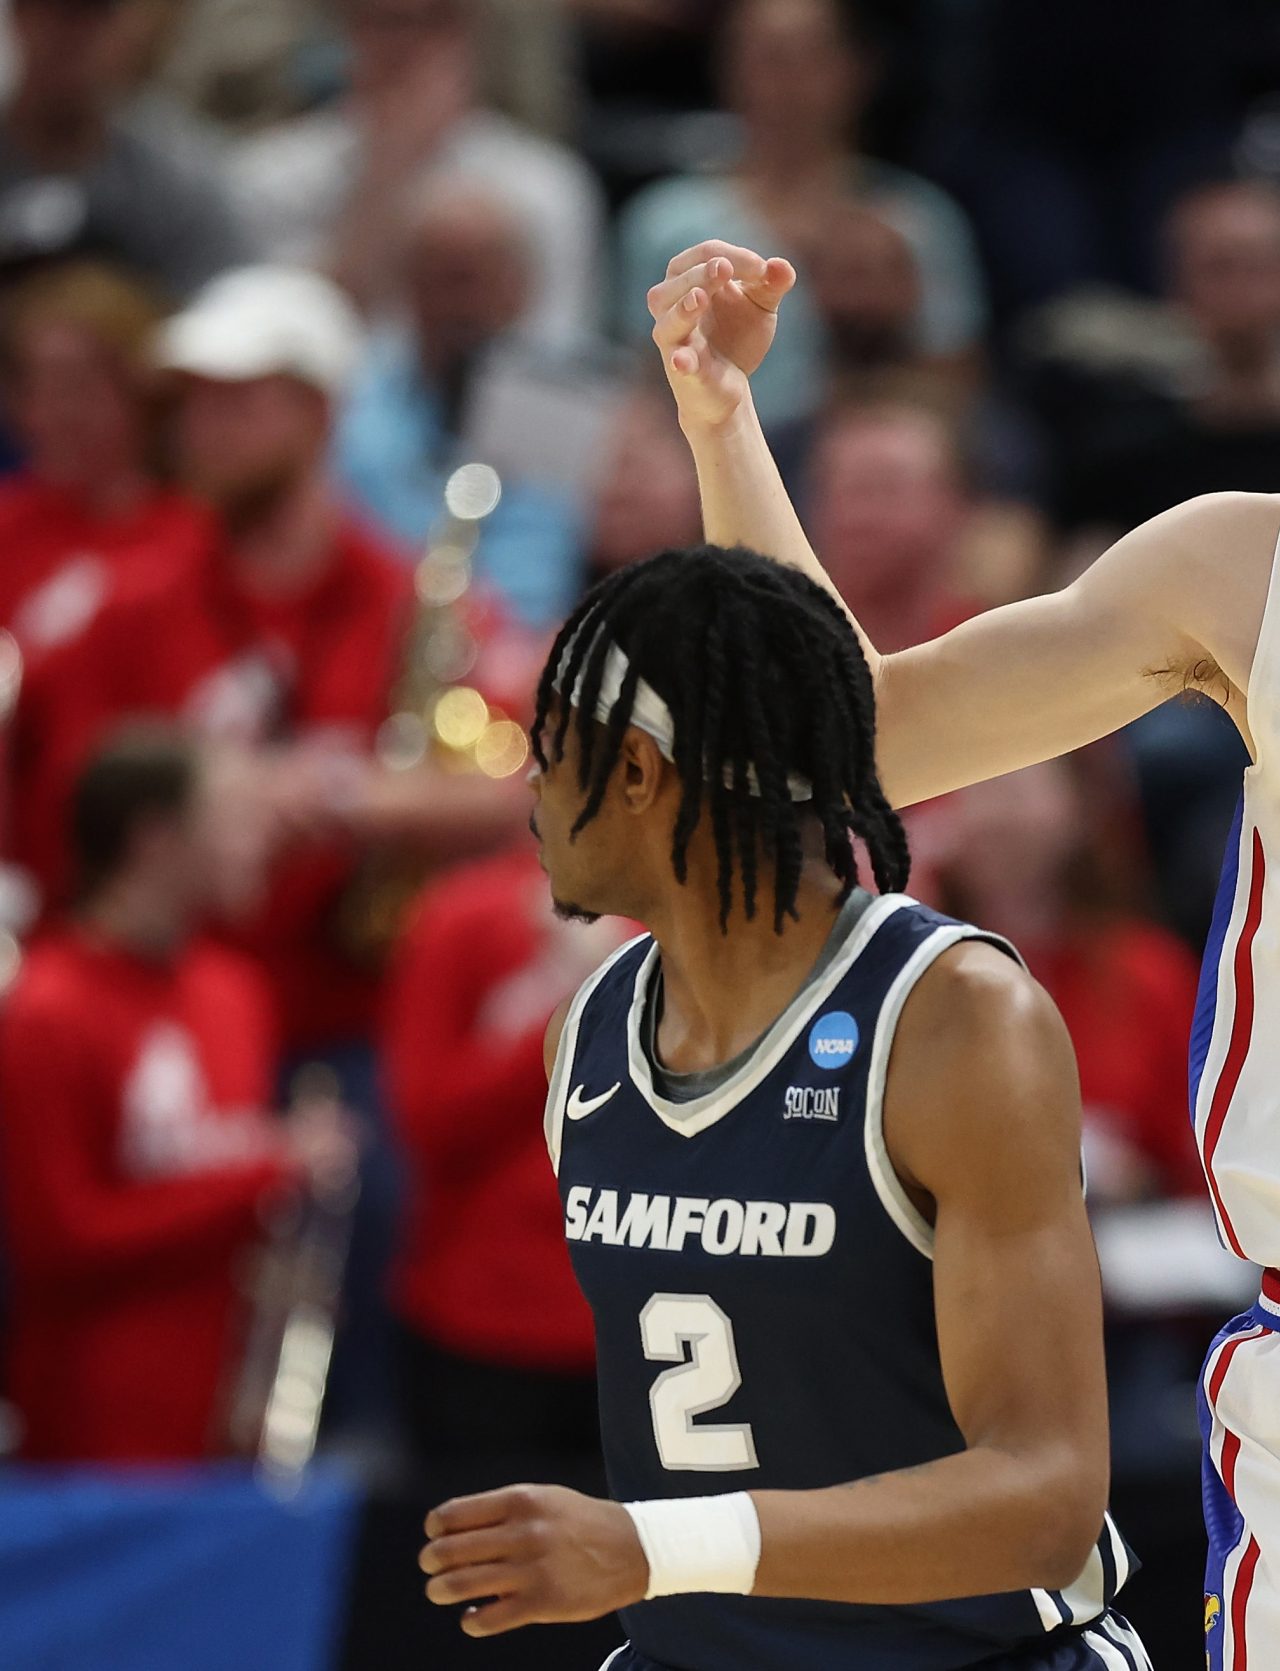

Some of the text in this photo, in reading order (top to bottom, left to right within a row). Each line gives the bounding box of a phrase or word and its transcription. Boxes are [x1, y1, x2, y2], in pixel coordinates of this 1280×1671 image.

[814, 1038, 854, 1055] NCAA
[565, 1186, 837, 1258] SAMFORD
[638, 1292, 760, 1471] 2
